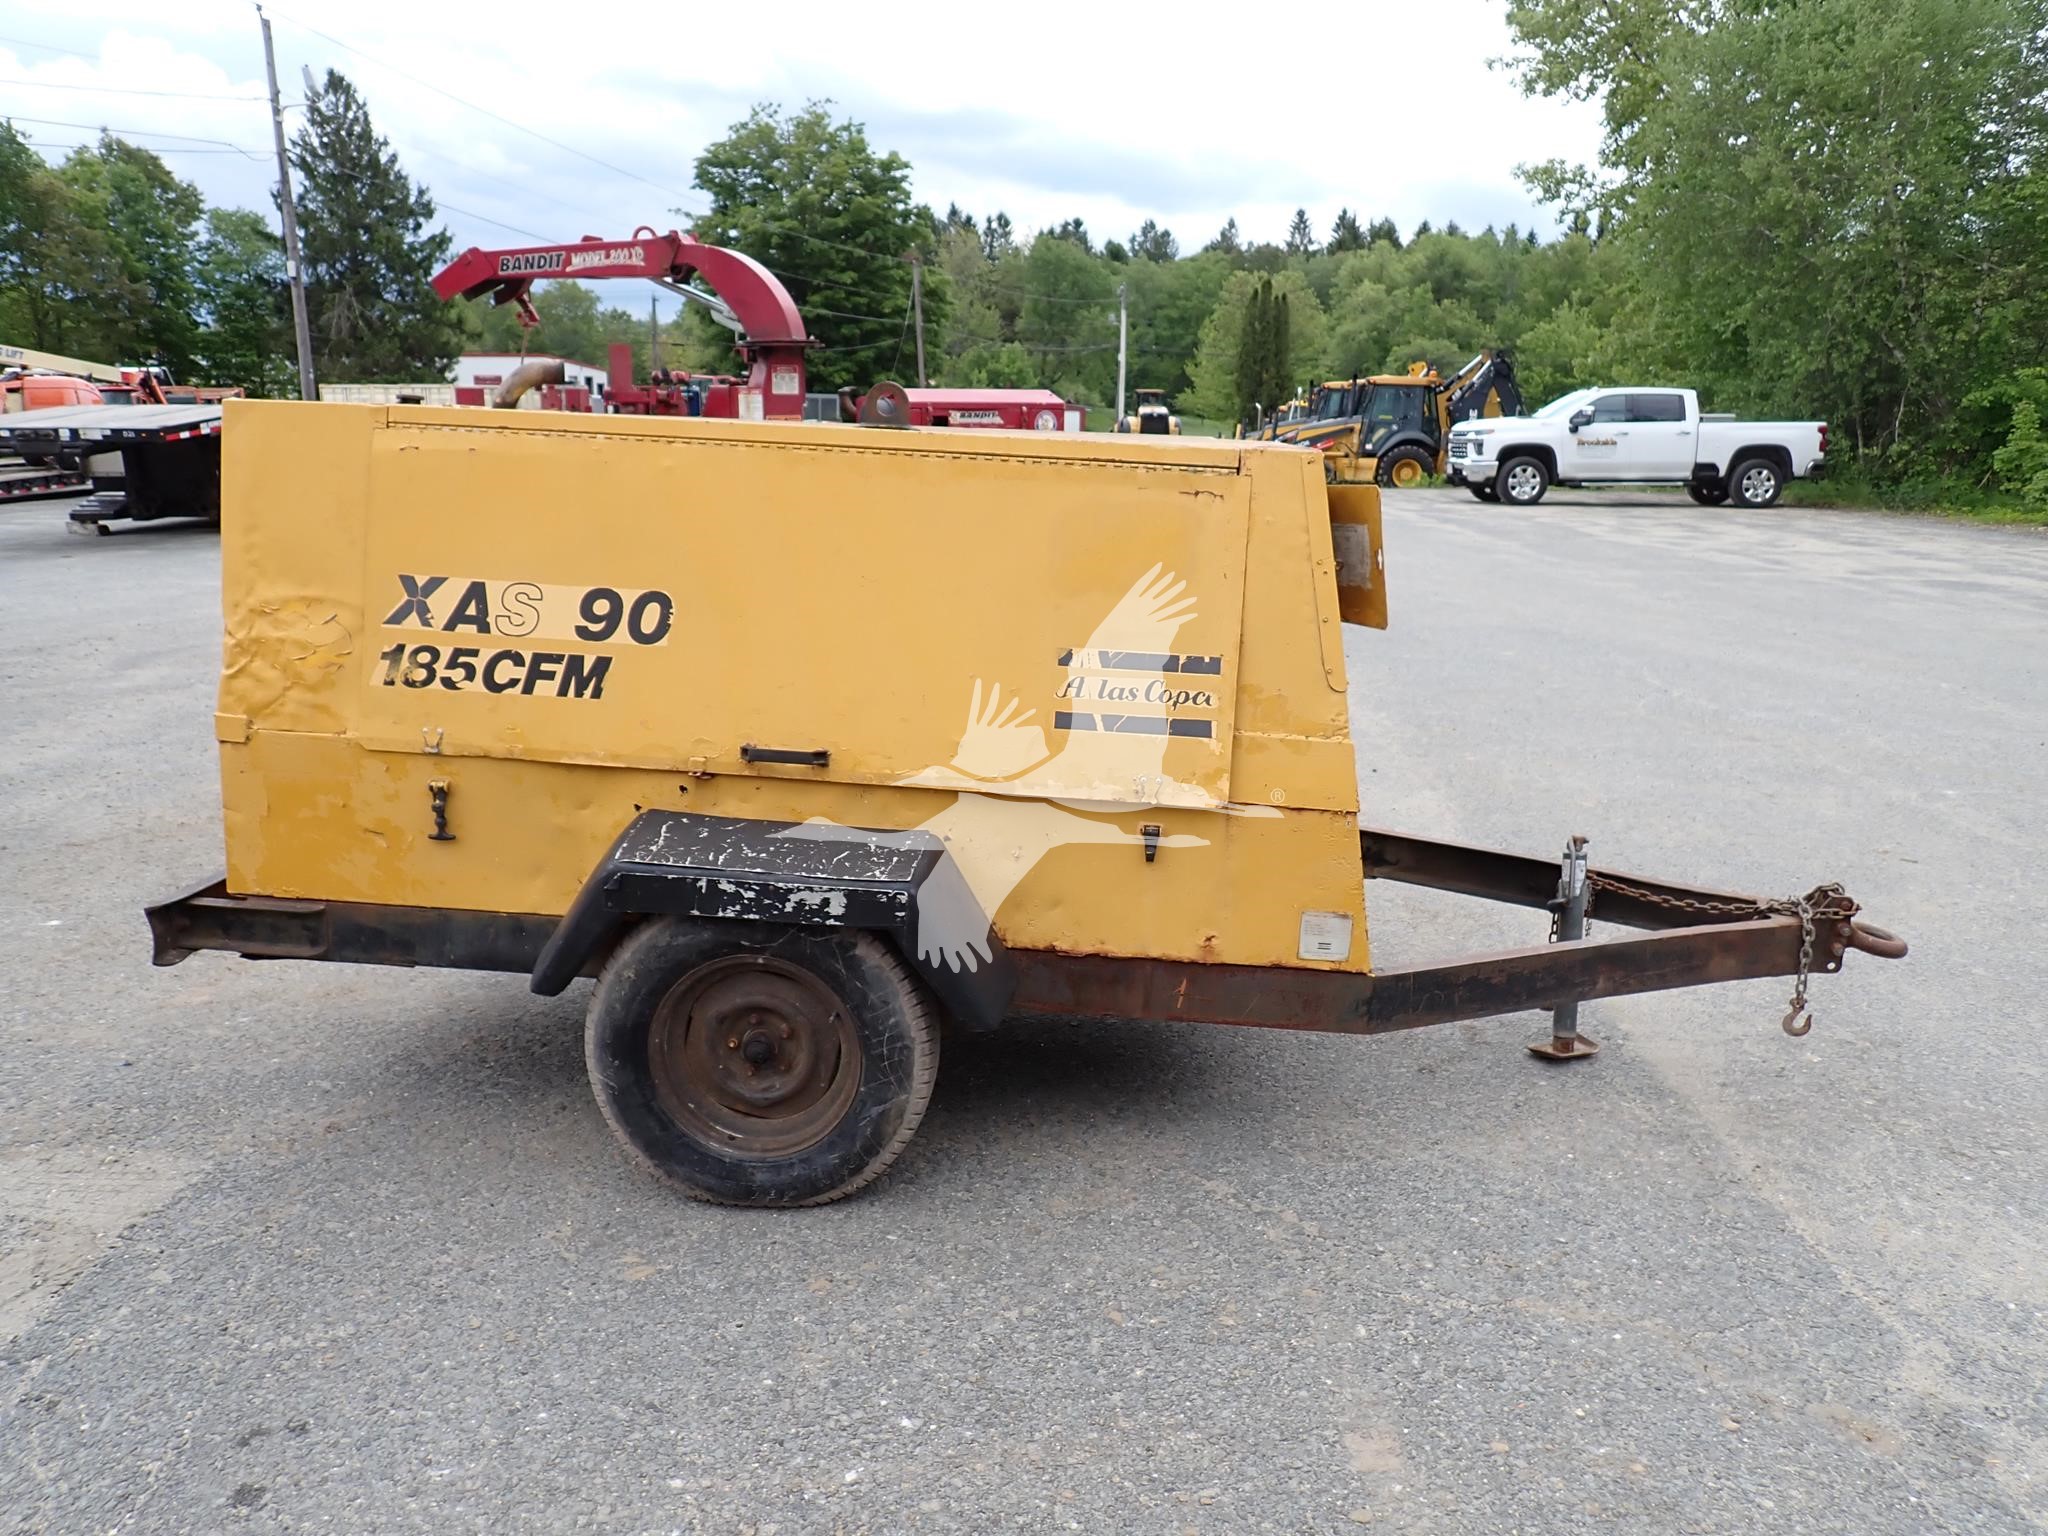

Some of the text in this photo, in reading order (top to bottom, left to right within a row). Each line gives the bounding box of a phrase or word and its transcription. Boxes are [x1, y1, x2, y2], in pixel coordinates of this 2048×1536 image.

[500, 252, 565, 273] BANDIT
[571, 250, 605, 266] MODEL
[960, 411, 997, 419] BANDIT
[382, 574, 675, 646] XAS 90
[380, 643, 614, 700] 185CFM
[1055, 676, 1139, 701] Alas
